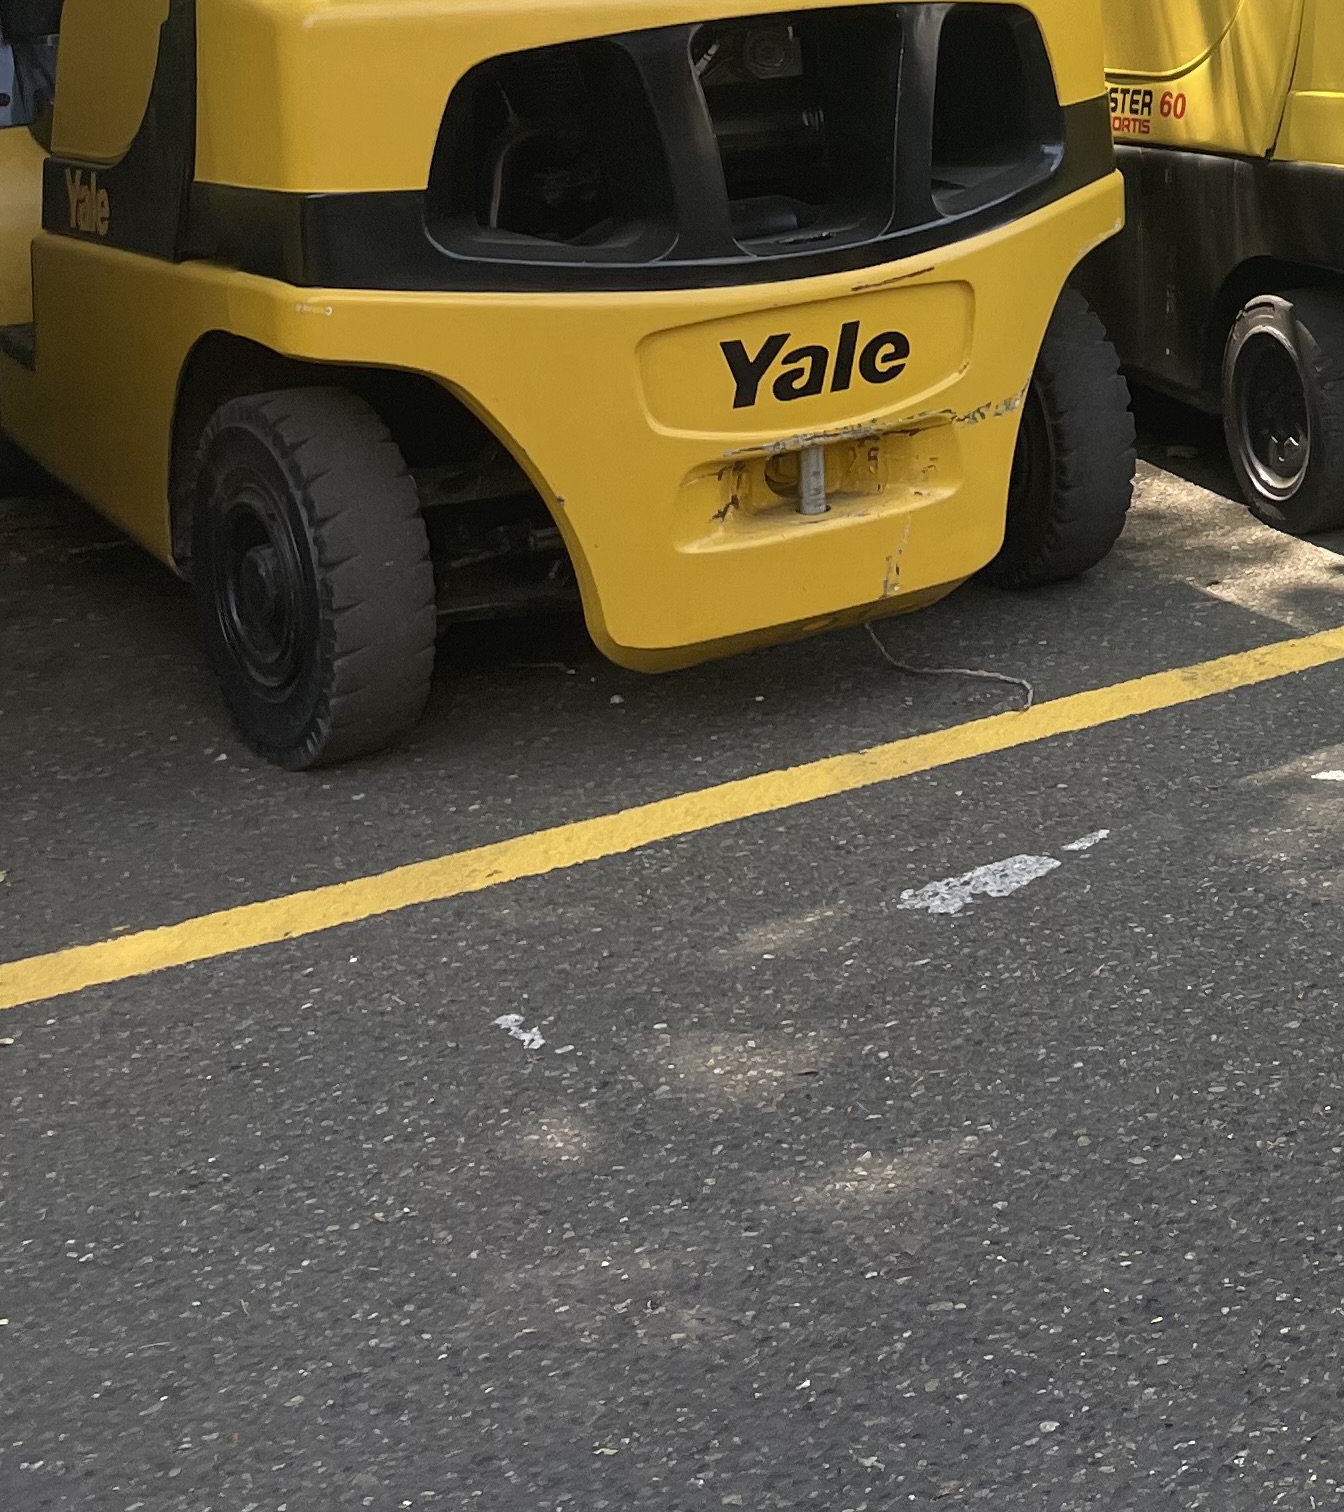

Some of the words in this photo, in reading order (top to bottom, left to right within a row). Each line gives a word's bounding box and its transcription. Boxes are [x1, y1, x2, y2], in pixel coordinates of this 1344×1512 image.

[1109, 87, 1153, 116] STER
[1160, 91, 1187, 119] 60
[1112, 116, 1150, 134] ORTIS
[65, 168, 110, 236] Yale
[719, 320, 910, 409] Yale
